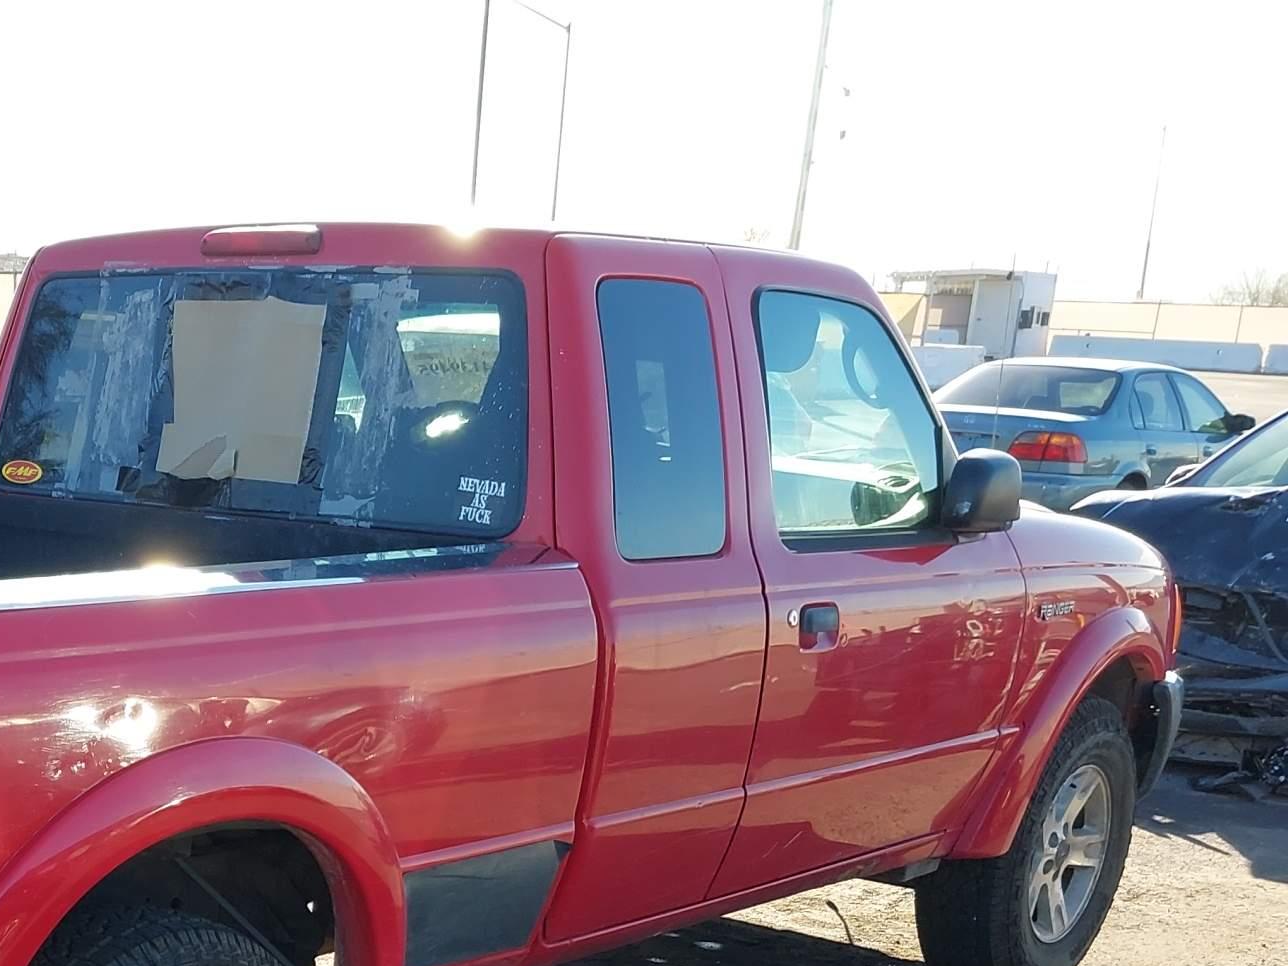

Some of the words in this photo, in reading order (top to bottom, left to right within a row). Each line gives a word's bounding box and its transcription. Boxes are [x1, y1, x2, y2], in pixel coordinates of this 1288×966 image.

[4, 466, 39, 476] FMF
[458, 476, 506, 497] NEVADA
[471, 493, 489, 509] AS
[459, 505, 492, 525] FUCK
[1040, 601, 1076, 620] RANGER
